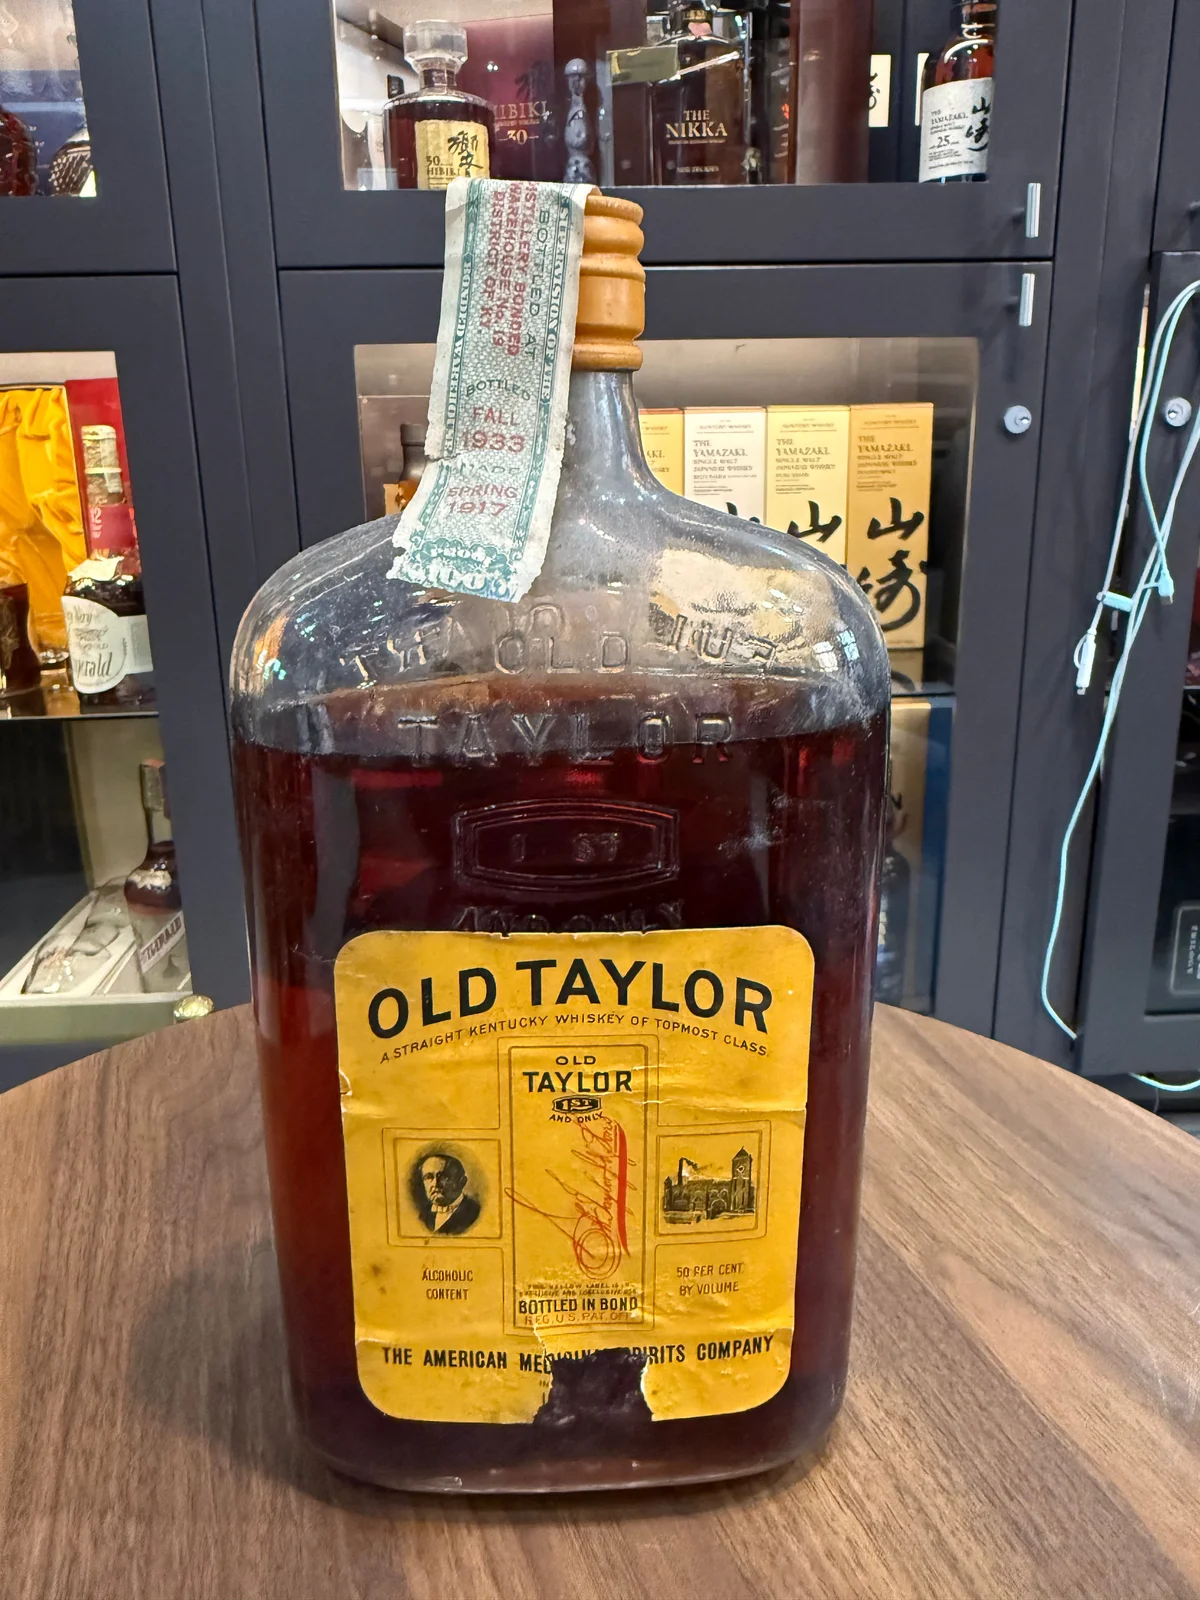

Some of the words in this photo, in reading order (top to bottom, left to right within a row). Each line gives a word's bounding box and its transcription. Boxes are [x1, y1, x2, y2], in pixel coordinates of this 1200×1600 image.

[683, 110, 710, 121] THE
[507, 129, 528, 145] 30
[665, 122, 728, 138] NIKKA
[426, 156, 440, 167] 30
[487, 190, 506, 269] DISTRICT
[500, 182, 524, 294] WAREHOUSE
[529, 210, 550, 317] BOTTLED
[483, 276, 496, 299] OF
[507, 282, 526, 356] BONDED
[525, 332, 537, 361] AT
[466, 379, 531, 401] BOTTLED
[473, 407, 521, 426] FALL
[461, 431, 526, 453] 1933
[449, 484, 518, 499] SPRING
[449, 501, 509, 517] 1917
[494, 631, 631, 675] OLD
[397, 713, 733, 768] TAYLOR
[368, 967, 497, 1039] OLD
[516, 958, 773, 1035] TAYLOR
[380, 1052, 390, 1064] A
[393, 1029, 464, 1059] STRAIGHT
[469, 1015, 549, 1037] KENTUCKY
[555, 1013, 625, 1024] WHISKEY
[631, 1016, 650, 1027] OF
[655, 1018, 718, 1041] TOPMOST
[555, 1056, 597, 1066] OLD
[522, 1070, 632, 1093] TAYLOR
[562, 1098, 593, 1111] 1ST
[549, 1113, 572, 1123] AND
[577, 1111, 603, 1124] ONLY
[422, 1267, 474, 1281] ALCOHOLIC
[677, 1266, 690, 1279] 50
[694, 1264, 713, 1277] PER
[718, 1262, 743, 1275] CENT
[426, 1288, 469, 1300] CONTENT
[679, 1285, 694, 1296] BY
[697, 1281, 740, 1295] VOLUME
[519, 1298, 577, 1315] BOTTLED
[582, 1298, 596, 1311] IN
[600, 1296, 638, 1311] BOND
[381, 1347, 413, 1365] THE
[424, 1349, 507, 1369] AMERICAN
[696, 1335, 774, 1361] COMPANY
